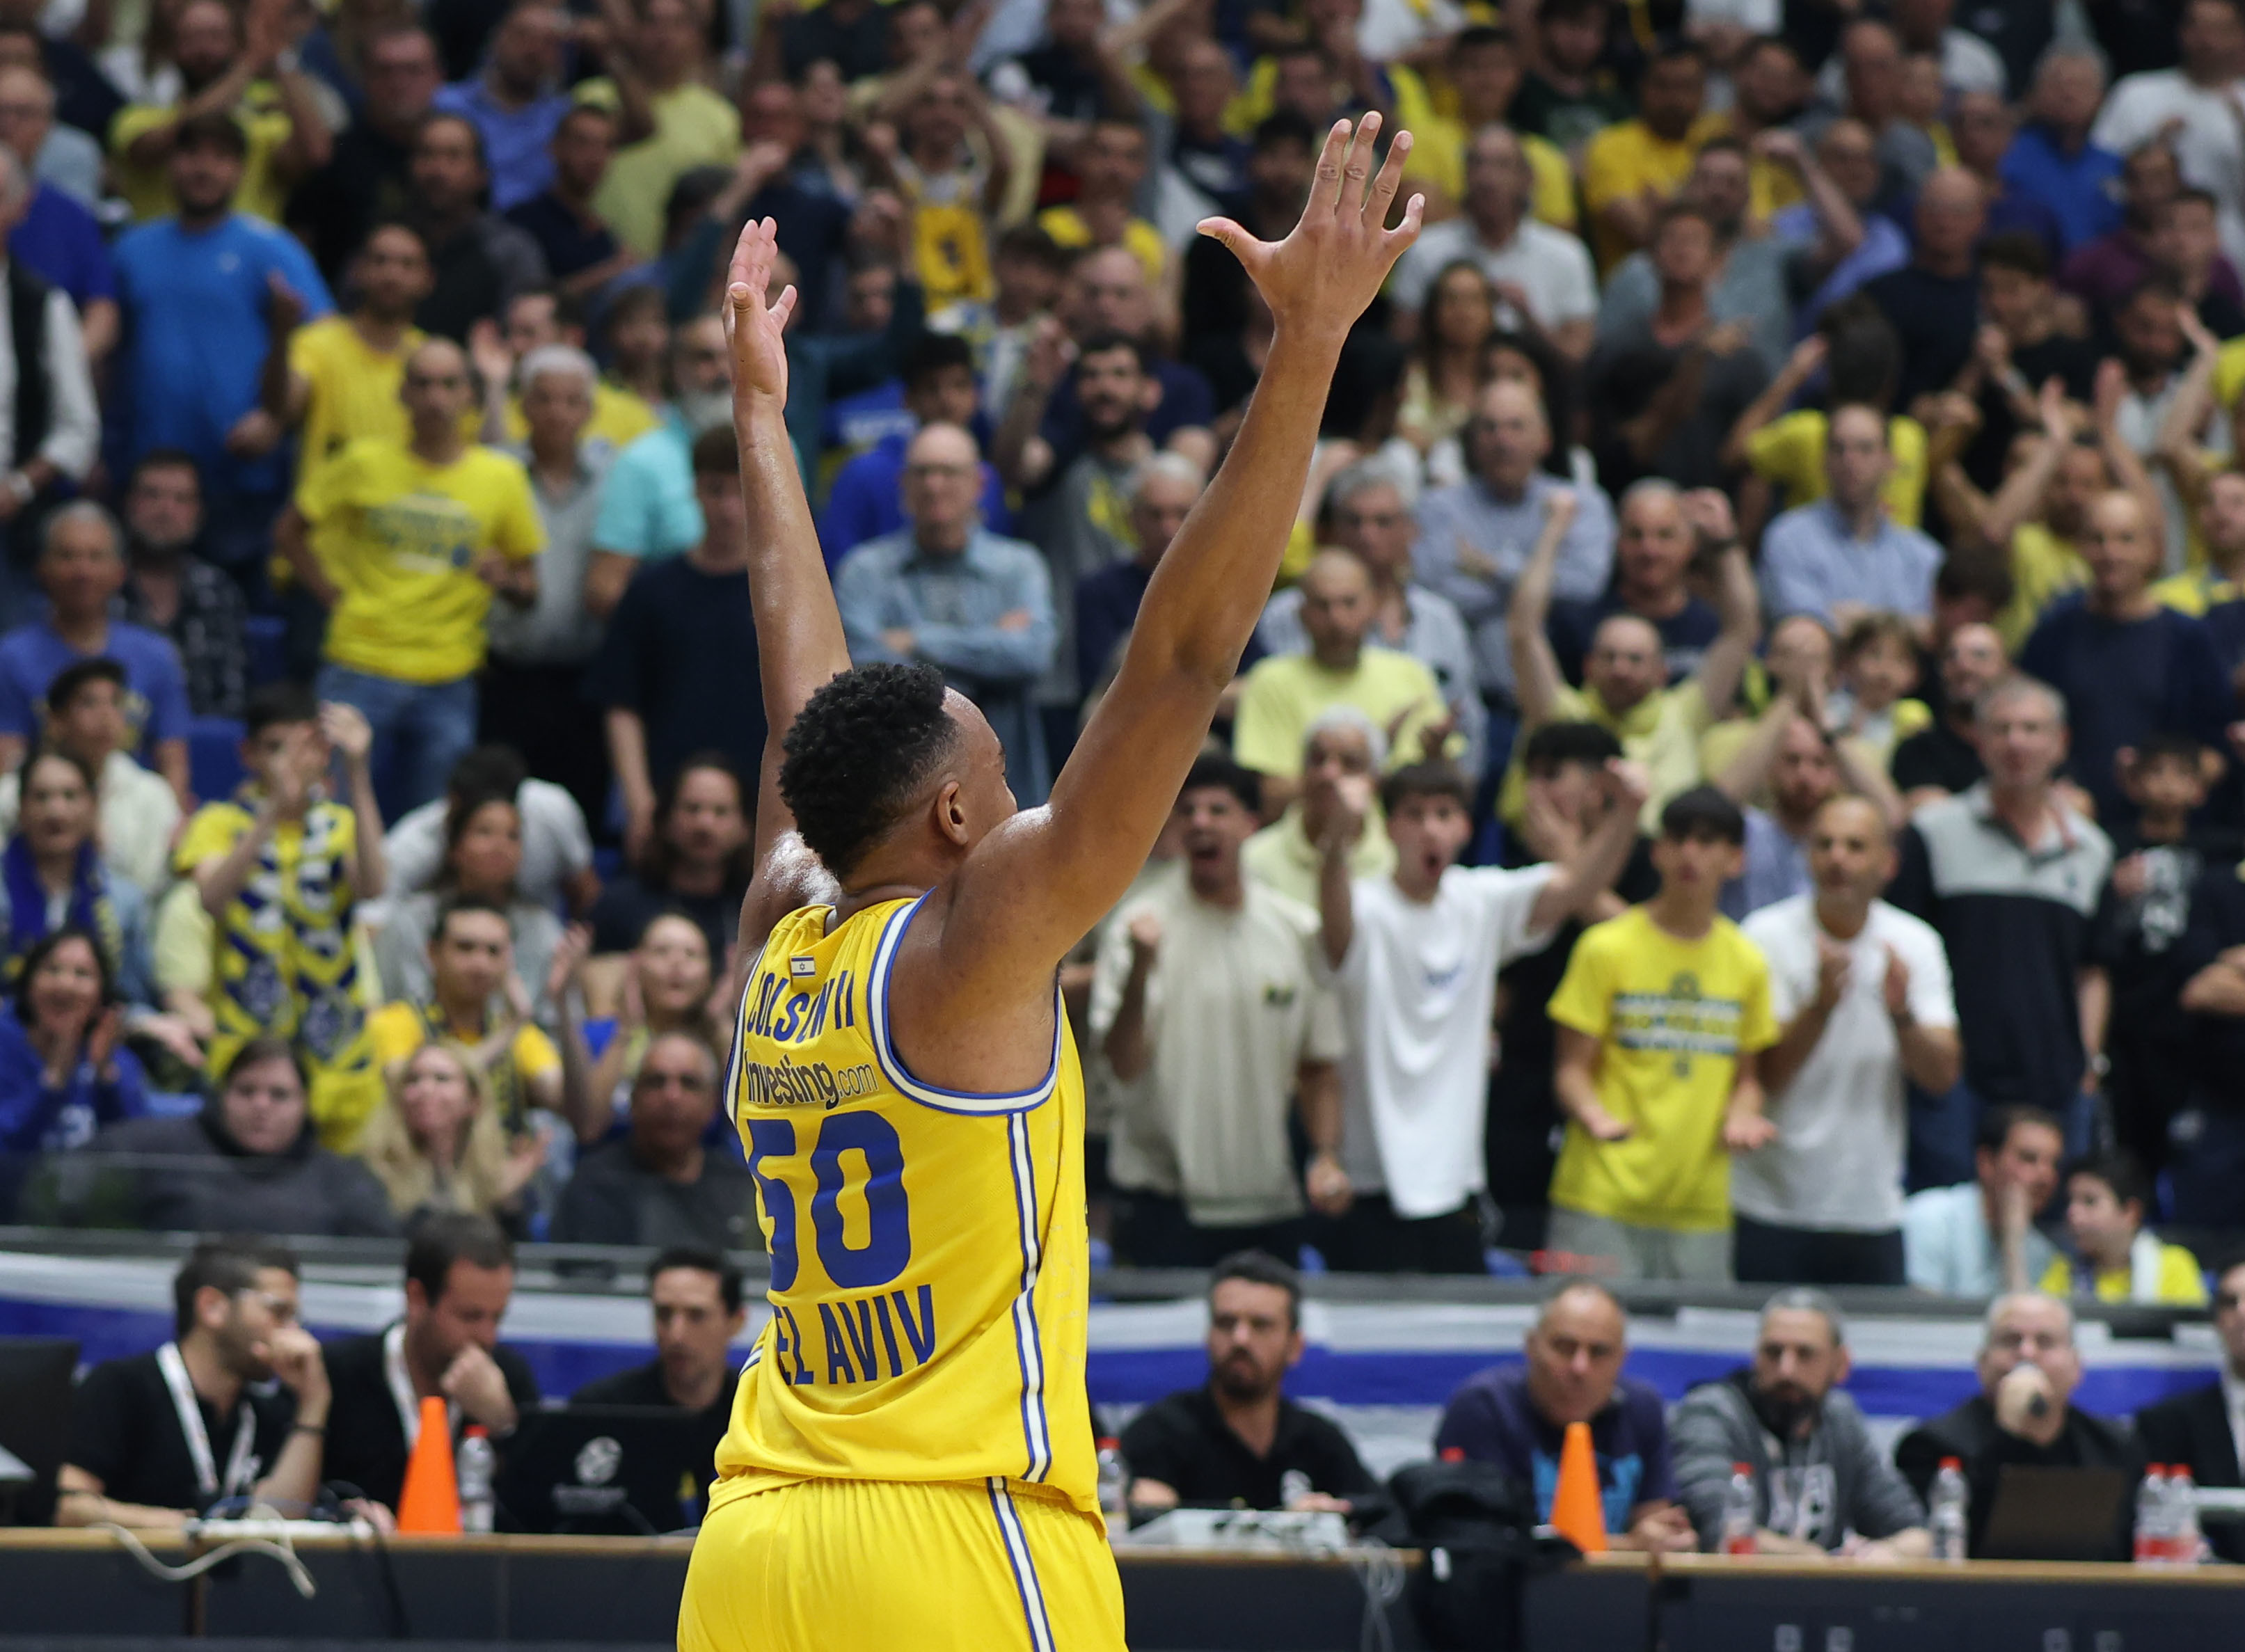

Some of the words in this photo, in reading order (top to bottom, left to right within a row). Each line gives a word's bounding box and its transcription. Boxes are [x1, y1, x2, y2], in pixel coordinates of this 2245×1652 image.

[835, 970, 855, 1030] II
[745, 1050, 879, 1111] Investing.com
[747, 1110, 912, 1292] 50
[817, 1284, 936, 1385] AVIV
